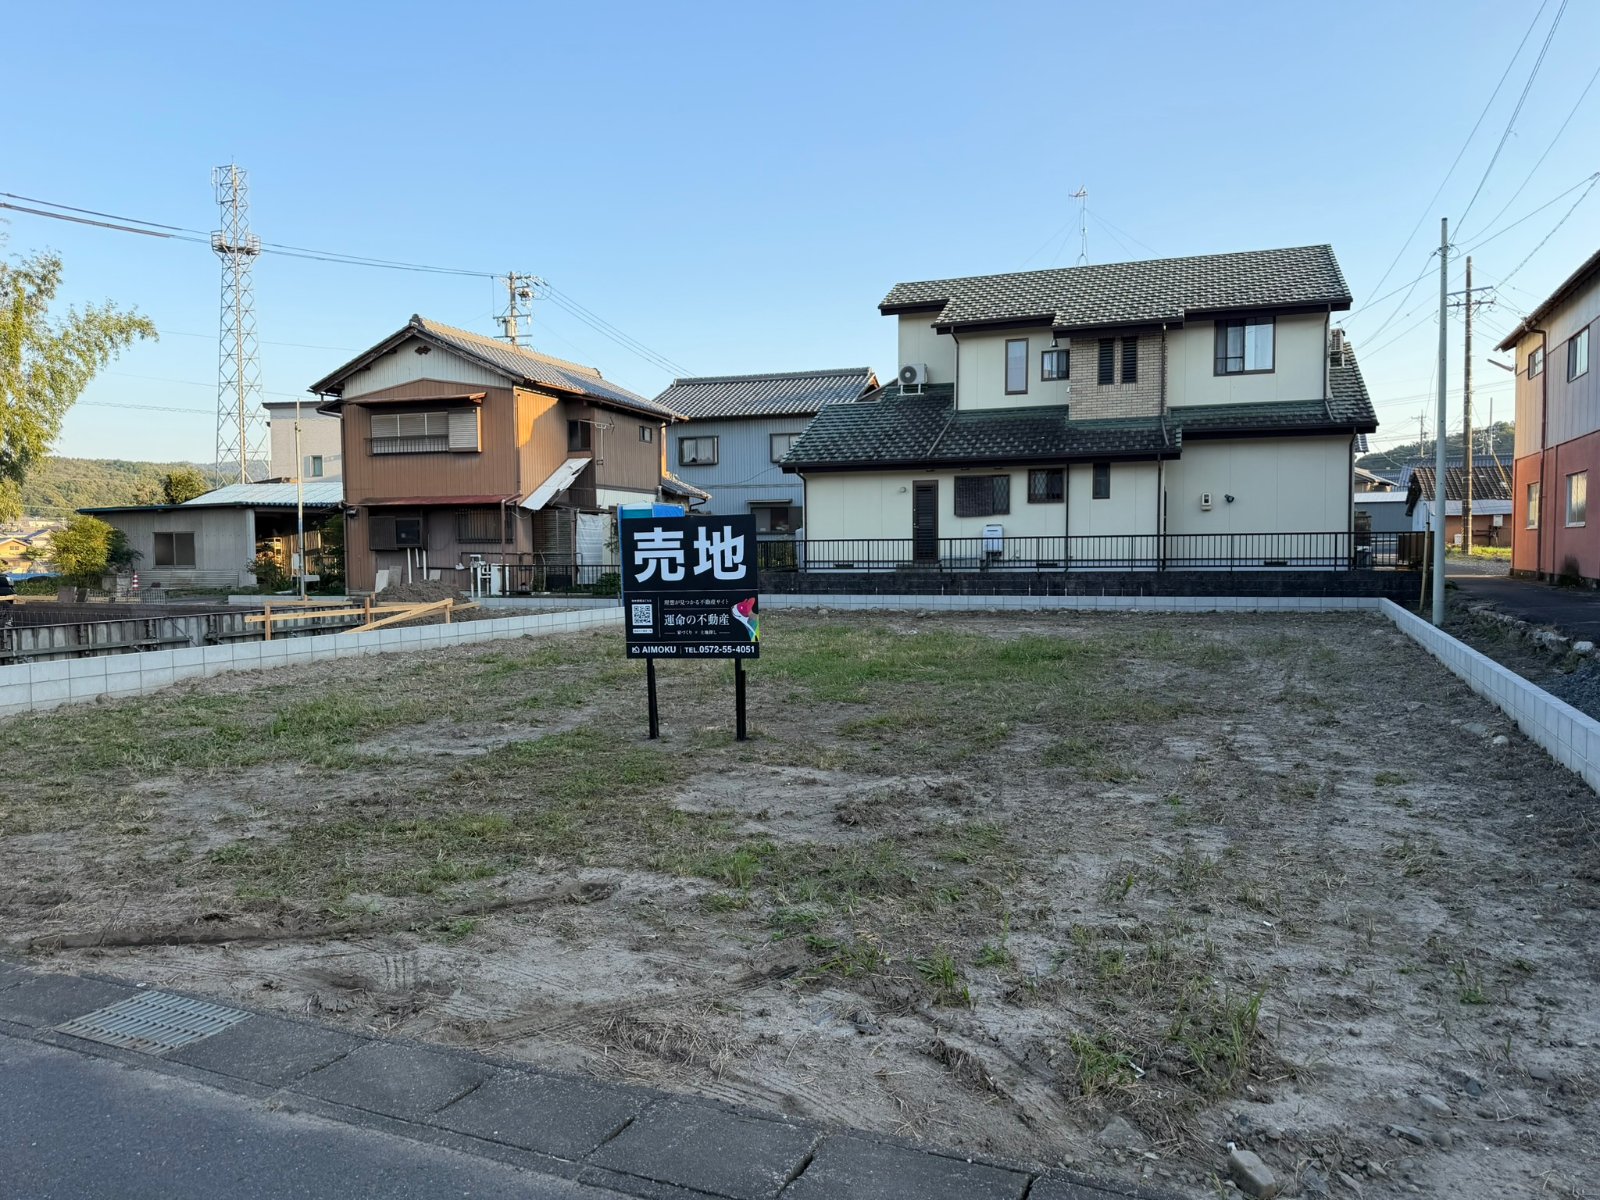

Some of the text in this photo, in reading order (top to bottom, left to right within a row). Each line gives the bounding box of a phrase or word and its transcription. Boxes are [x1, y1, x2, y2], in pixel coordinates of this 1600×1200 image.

[633, 525, 747, 583] 売地
[664, 613, 730, 626] 運命の不動産
[641, 646, 677, 654] AIMOKU
